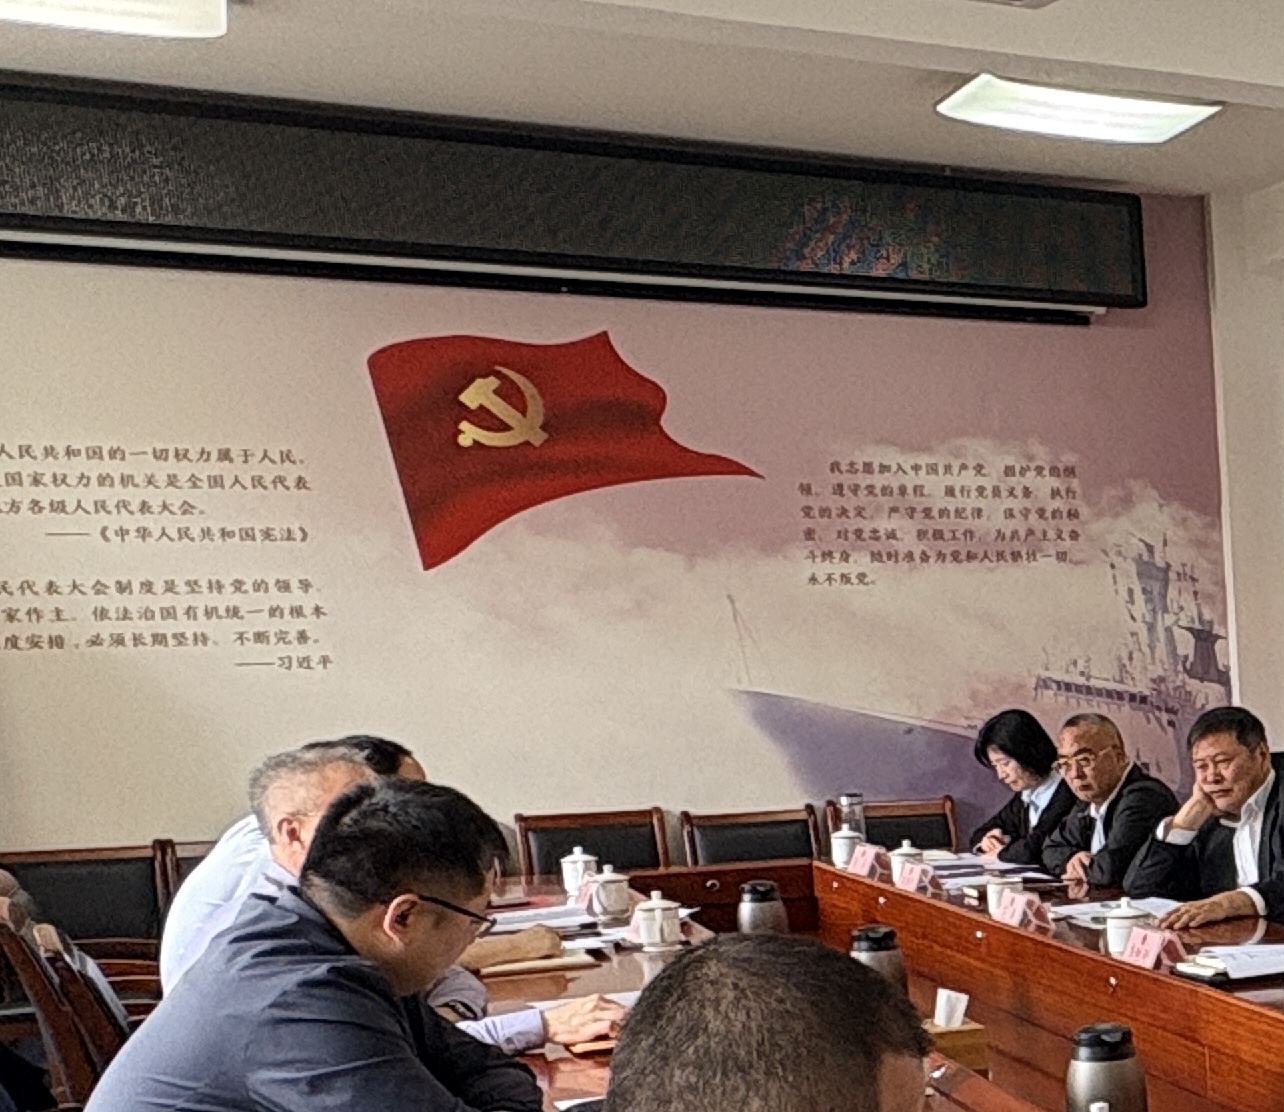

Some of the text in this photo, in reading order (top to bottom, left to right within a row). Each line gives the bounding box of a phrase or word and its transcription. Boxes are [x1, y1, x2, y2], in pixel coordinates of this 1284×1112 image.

[0, 471, 311, 491] 国家权力的机关是全国人民代表
[0, 499, 205, 515] 方各级人民代表大会。
